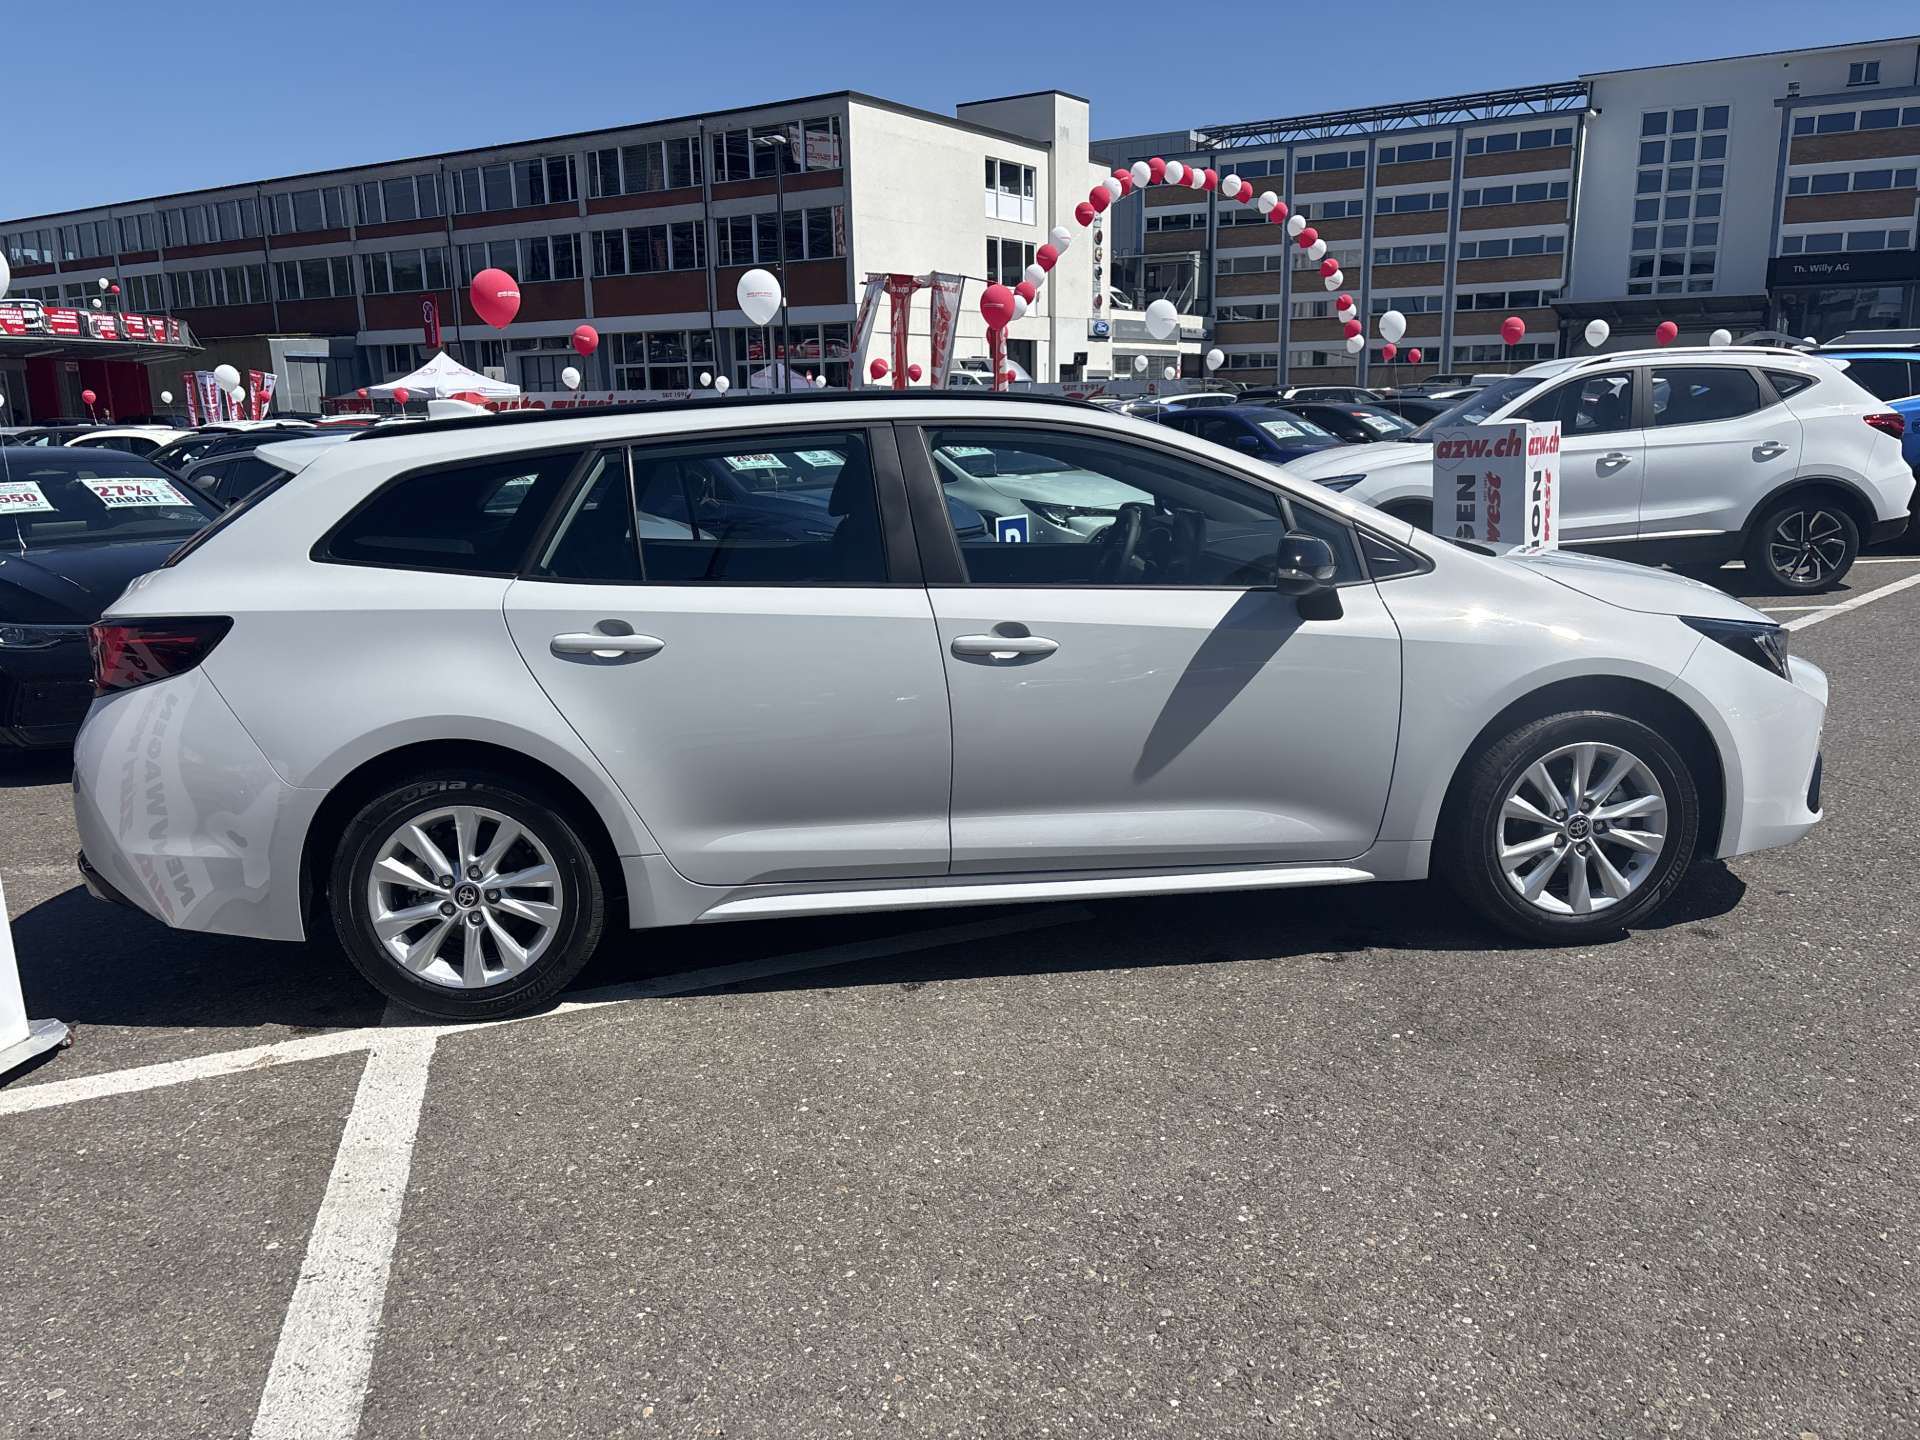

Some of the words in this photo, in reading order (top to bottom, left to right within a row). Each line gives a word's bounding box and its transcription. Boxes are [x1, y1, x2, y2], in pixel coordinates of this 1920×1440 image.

[1793, 265, 1807, 273] Th.
[1810, 263, 1833, 273] Willy
[1835, 263, 1850, 271] AG
[1437, 428, 1522, 459] azw.ch
[1527, 426, 1560, 456] azw.ch
[93, 485, 154, 497] 27%
[103, 496, 160, 504] RABATT
[1486, 470, 1502, 542] west
